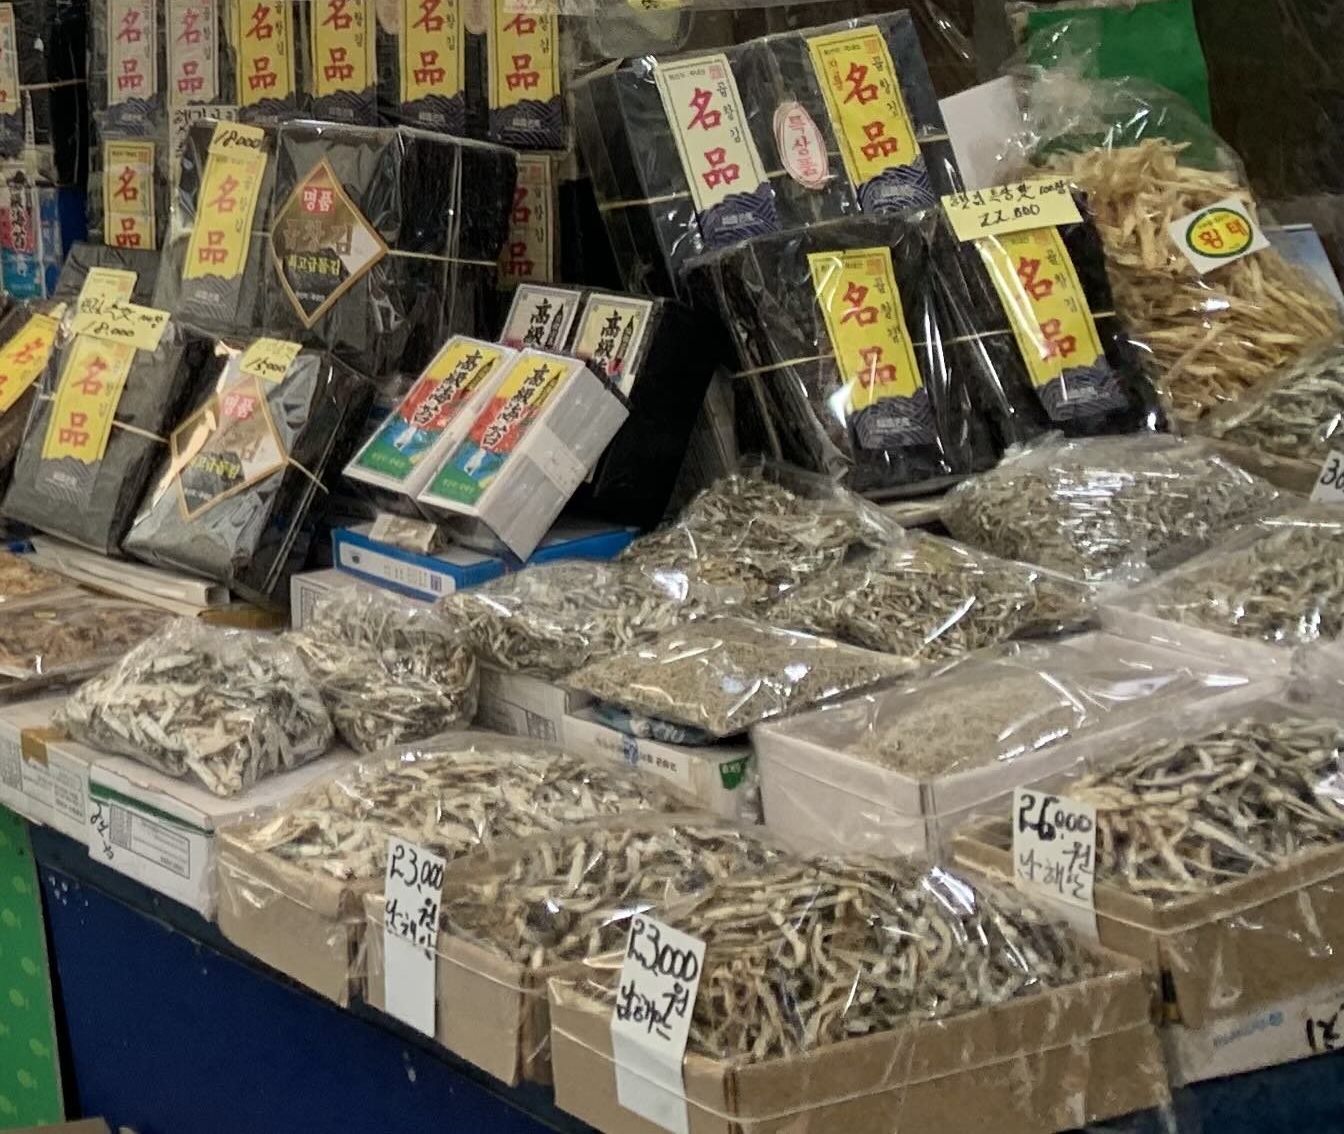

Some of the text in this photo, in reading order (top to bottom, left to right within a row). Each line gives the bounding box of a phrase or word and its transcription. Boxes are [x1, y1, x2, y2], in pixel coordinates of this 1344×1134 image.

[115, 7, 143, 92] 名品
[175, 7, 205, 93] 名品
[244, 1, 279, 93] 名品
[687, 87, 741, 190] 名品
[843, 62, 899, 164] 名品
[113, 166, 142, 248] 名品
[197, 173, 241, 266] 名品
[303, 188, 334, 213] 명품
[840, 284, 899, 393] 名品
[1015, 255, 1079, 360] 名品
[58, 357, 104, 450] 名品
